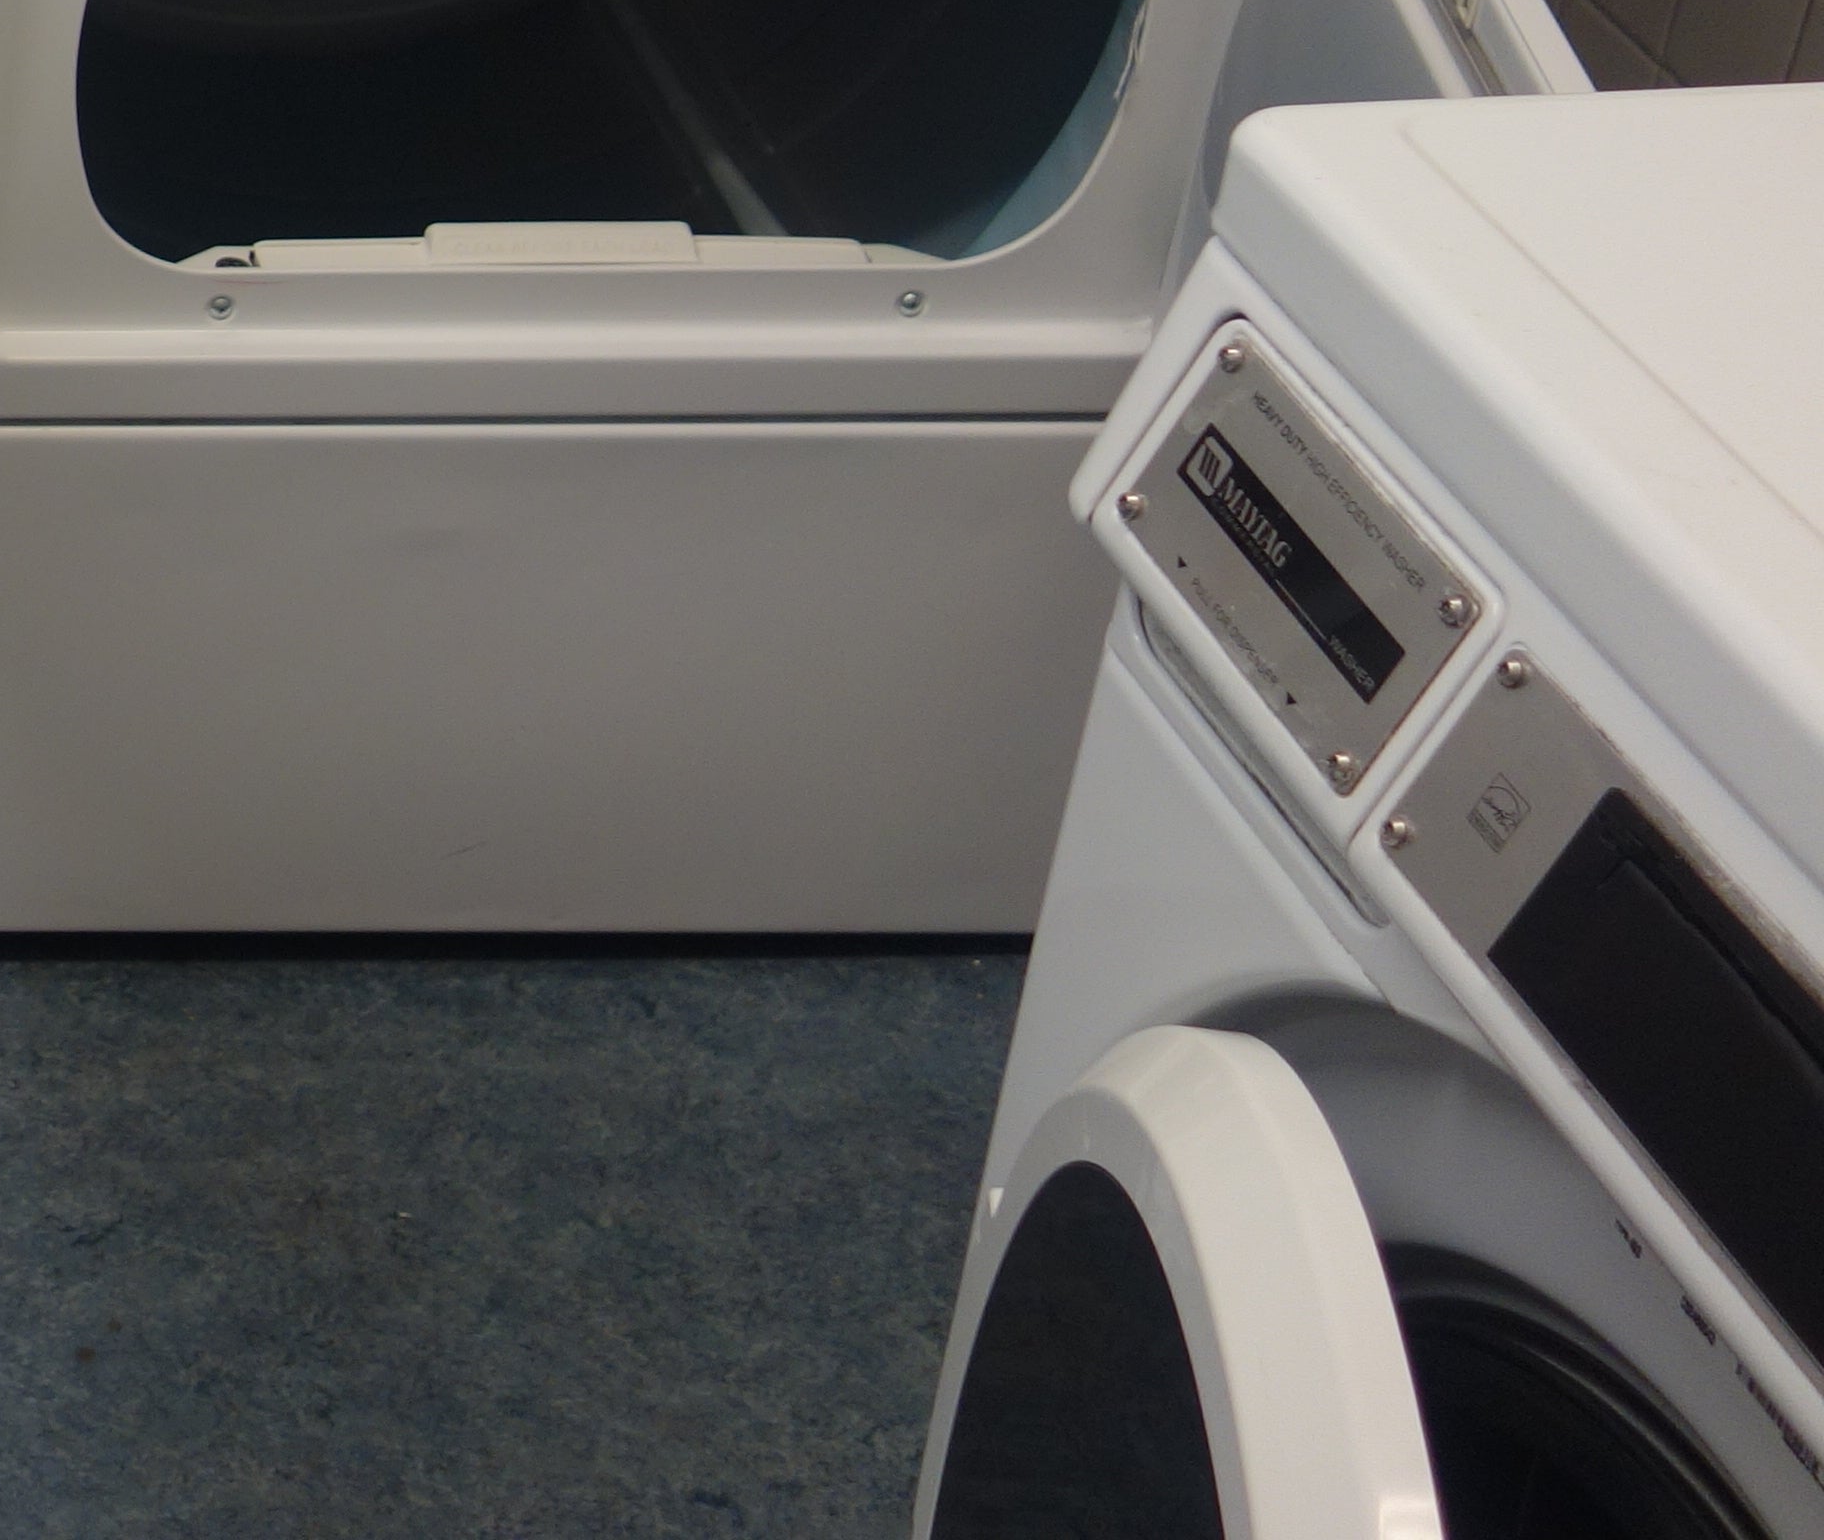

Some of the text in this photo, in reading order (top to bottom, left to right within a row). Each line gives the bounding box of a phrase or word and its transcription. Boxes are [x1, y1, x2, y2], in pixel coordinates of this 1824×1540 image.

[1216, 478, 1294, 568] MAYTAG
[1249, 391, 1427, 592] HEAVY DUTY HIGH EFFICIENCY WASHER
[1326, 636, 1375, 692] WASHER
